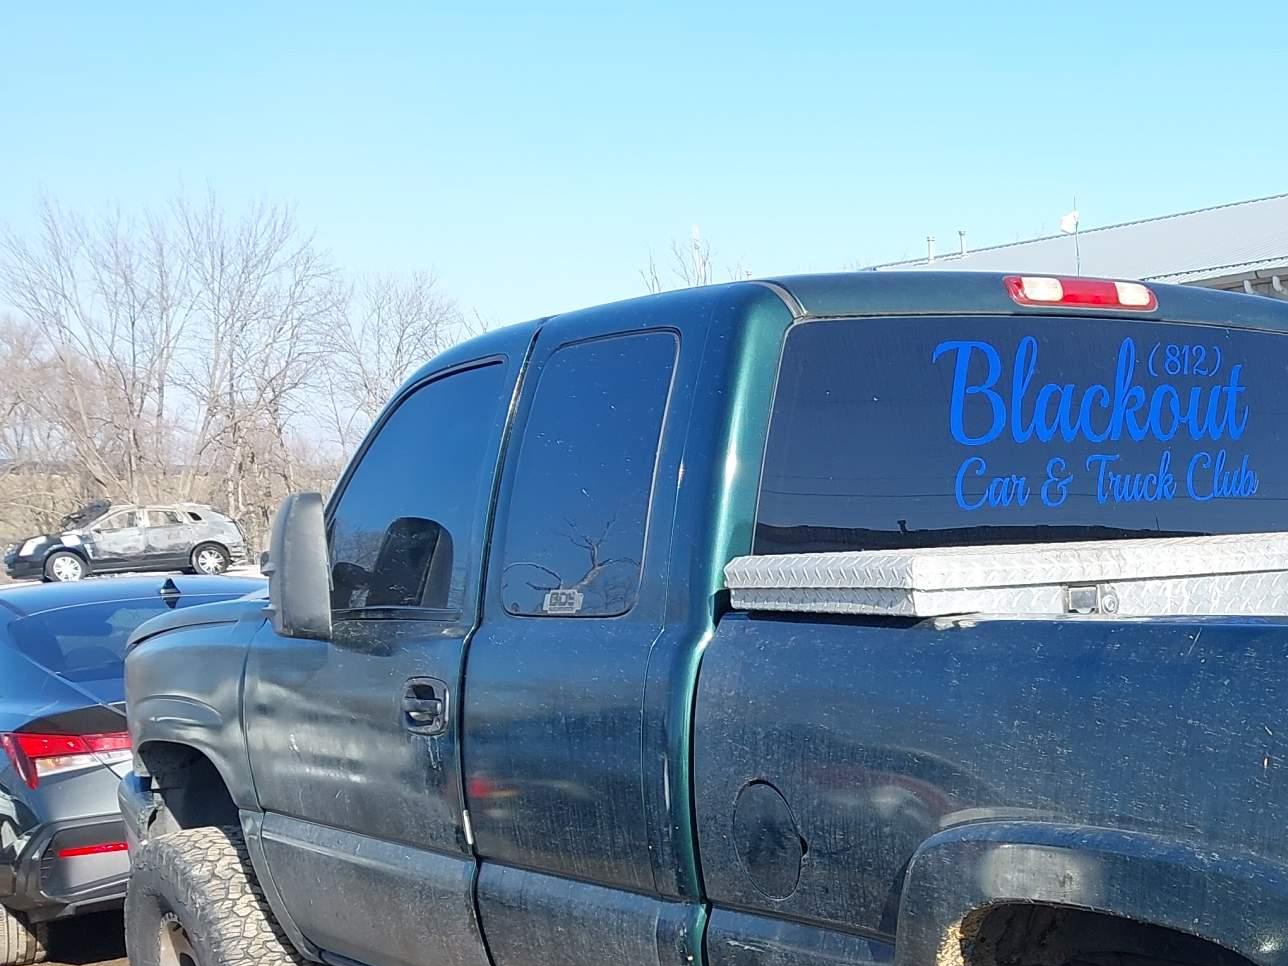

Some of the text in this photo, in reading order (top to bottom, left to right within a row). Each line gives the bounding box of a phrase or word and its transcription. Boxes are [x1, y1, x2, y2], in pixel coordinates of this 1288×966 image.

[932, 335, 1249, 446] Blackout
[1148, 342, 1222, 377] (812)
[955, 449, 1259, 511] Car & Truck Club
